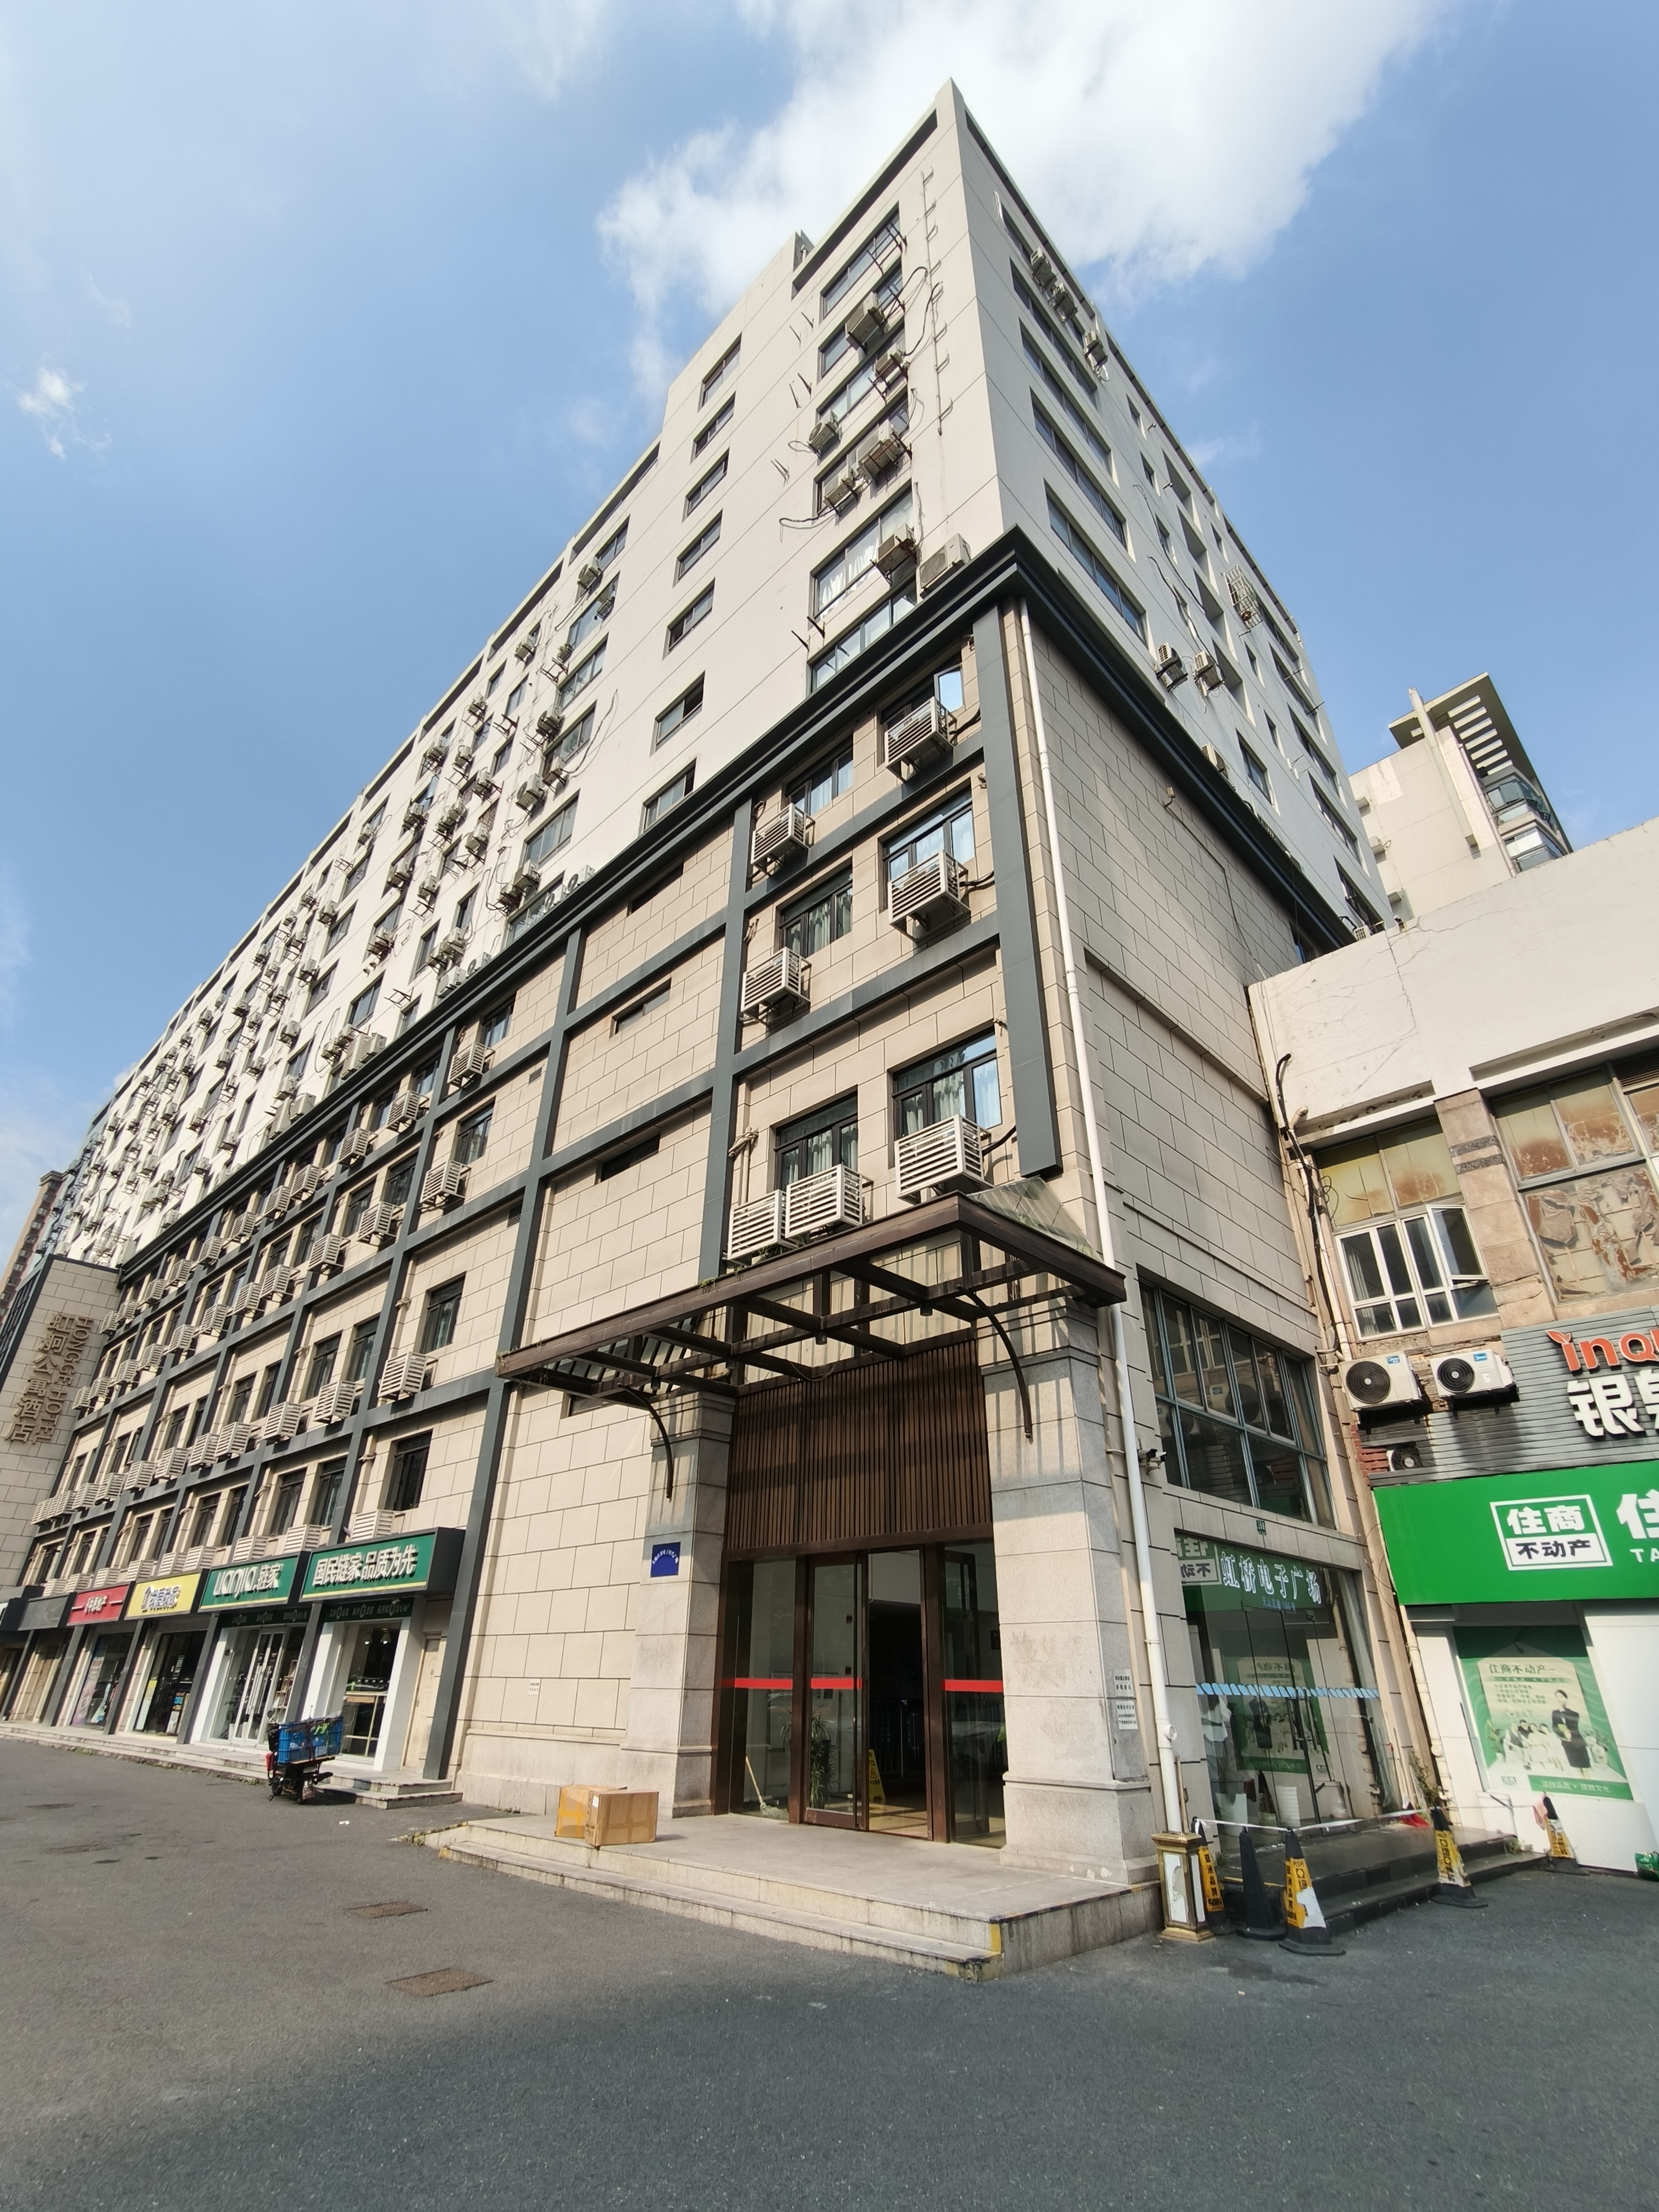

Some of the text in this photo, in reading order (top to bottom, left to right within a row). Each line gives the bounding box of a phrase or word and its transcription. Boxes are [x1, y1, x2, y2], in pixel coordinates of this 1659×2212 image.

[32, 1317, 94, 1445] HONGGE HOTEL
[1507, 1505, 1585, 1535] 住商
[360, 1544, 417, 1580] 品质为先
[1515, 1539, 1591, 1560] 不动产
[1220, 1551, 1321, 1604] 虹桥电子广场
